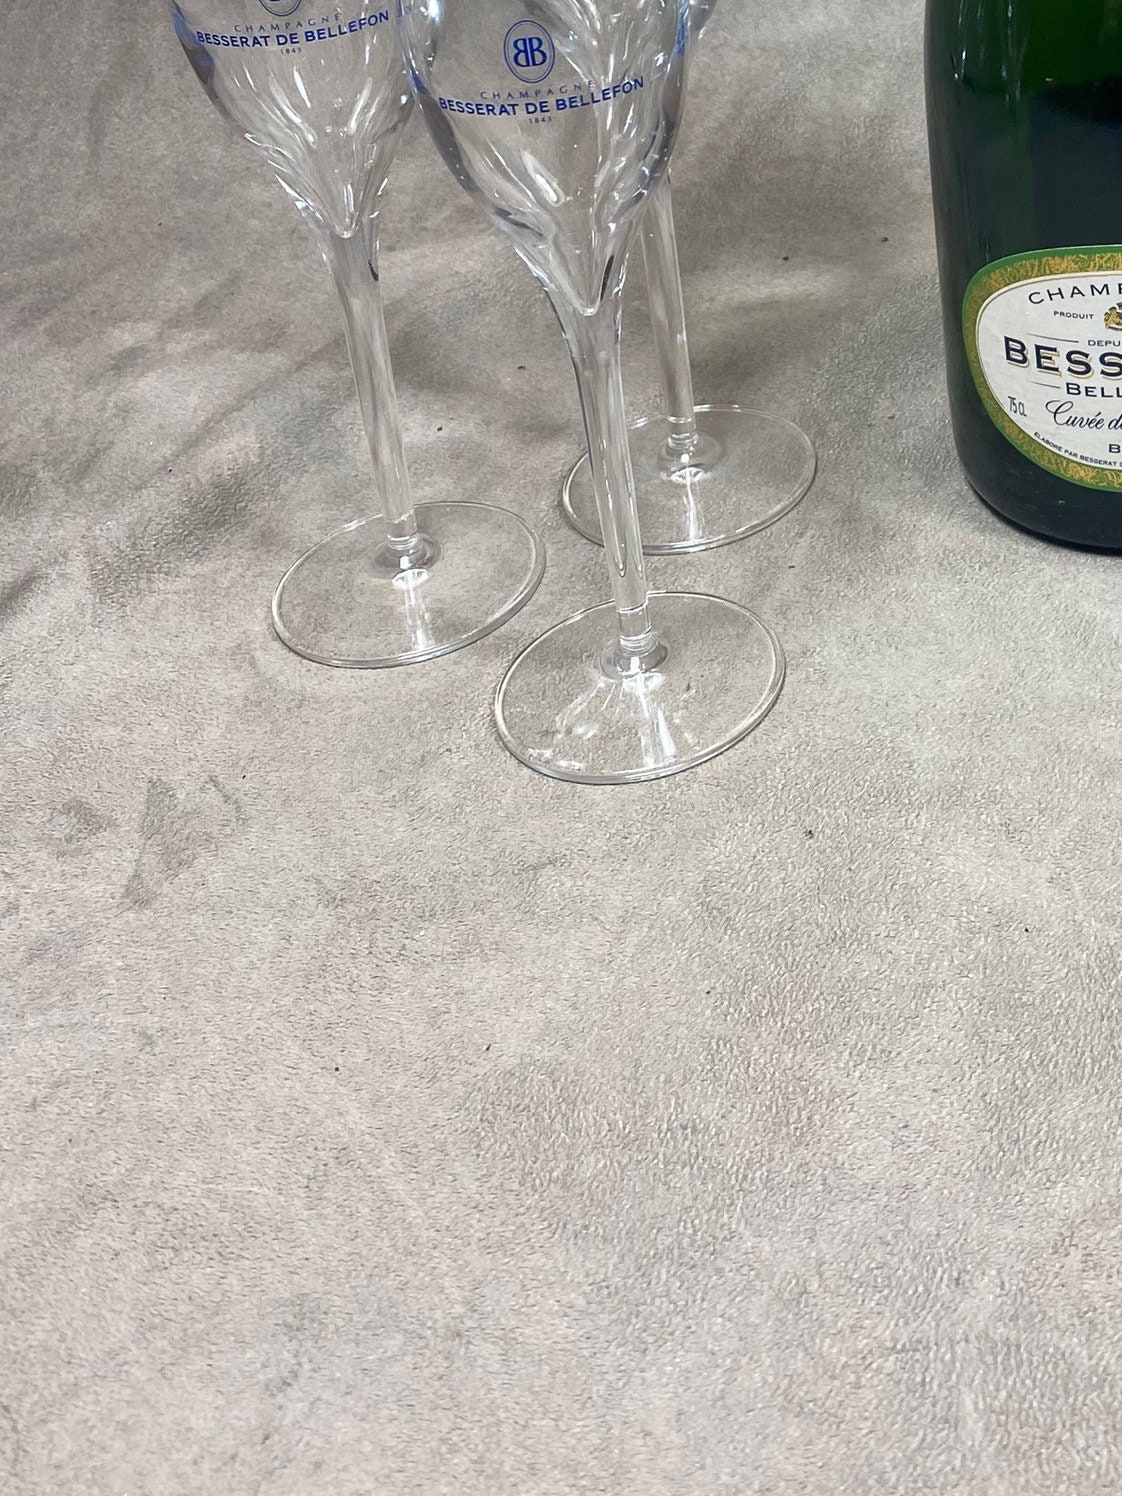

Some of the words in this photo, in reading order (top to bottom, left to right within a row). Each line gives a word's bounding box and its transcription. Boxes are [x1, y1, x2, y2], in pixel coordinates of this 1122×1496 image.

[196, 31, 271, 48] BESSERAT
[276, 33, 300, 45] DE
[304, 9, 389, 43] BELLEFON
[234, 13, 343, 33] CHAMPAGNE
[438, 97, 519, 116] BESSERAT
[525, 102, 550, 115] DE
[556, 76, 644, 112] BELLEFON
[480, 80, 596, 100] CHAMPAGNE
[1053, 310, 1094, 320] PRODUIT
[1045, 400, 1104, 430] Cuvée
[1064, 449, 1078, 458] PAR
[1080, 455, 1117, 467] BESSERAT
